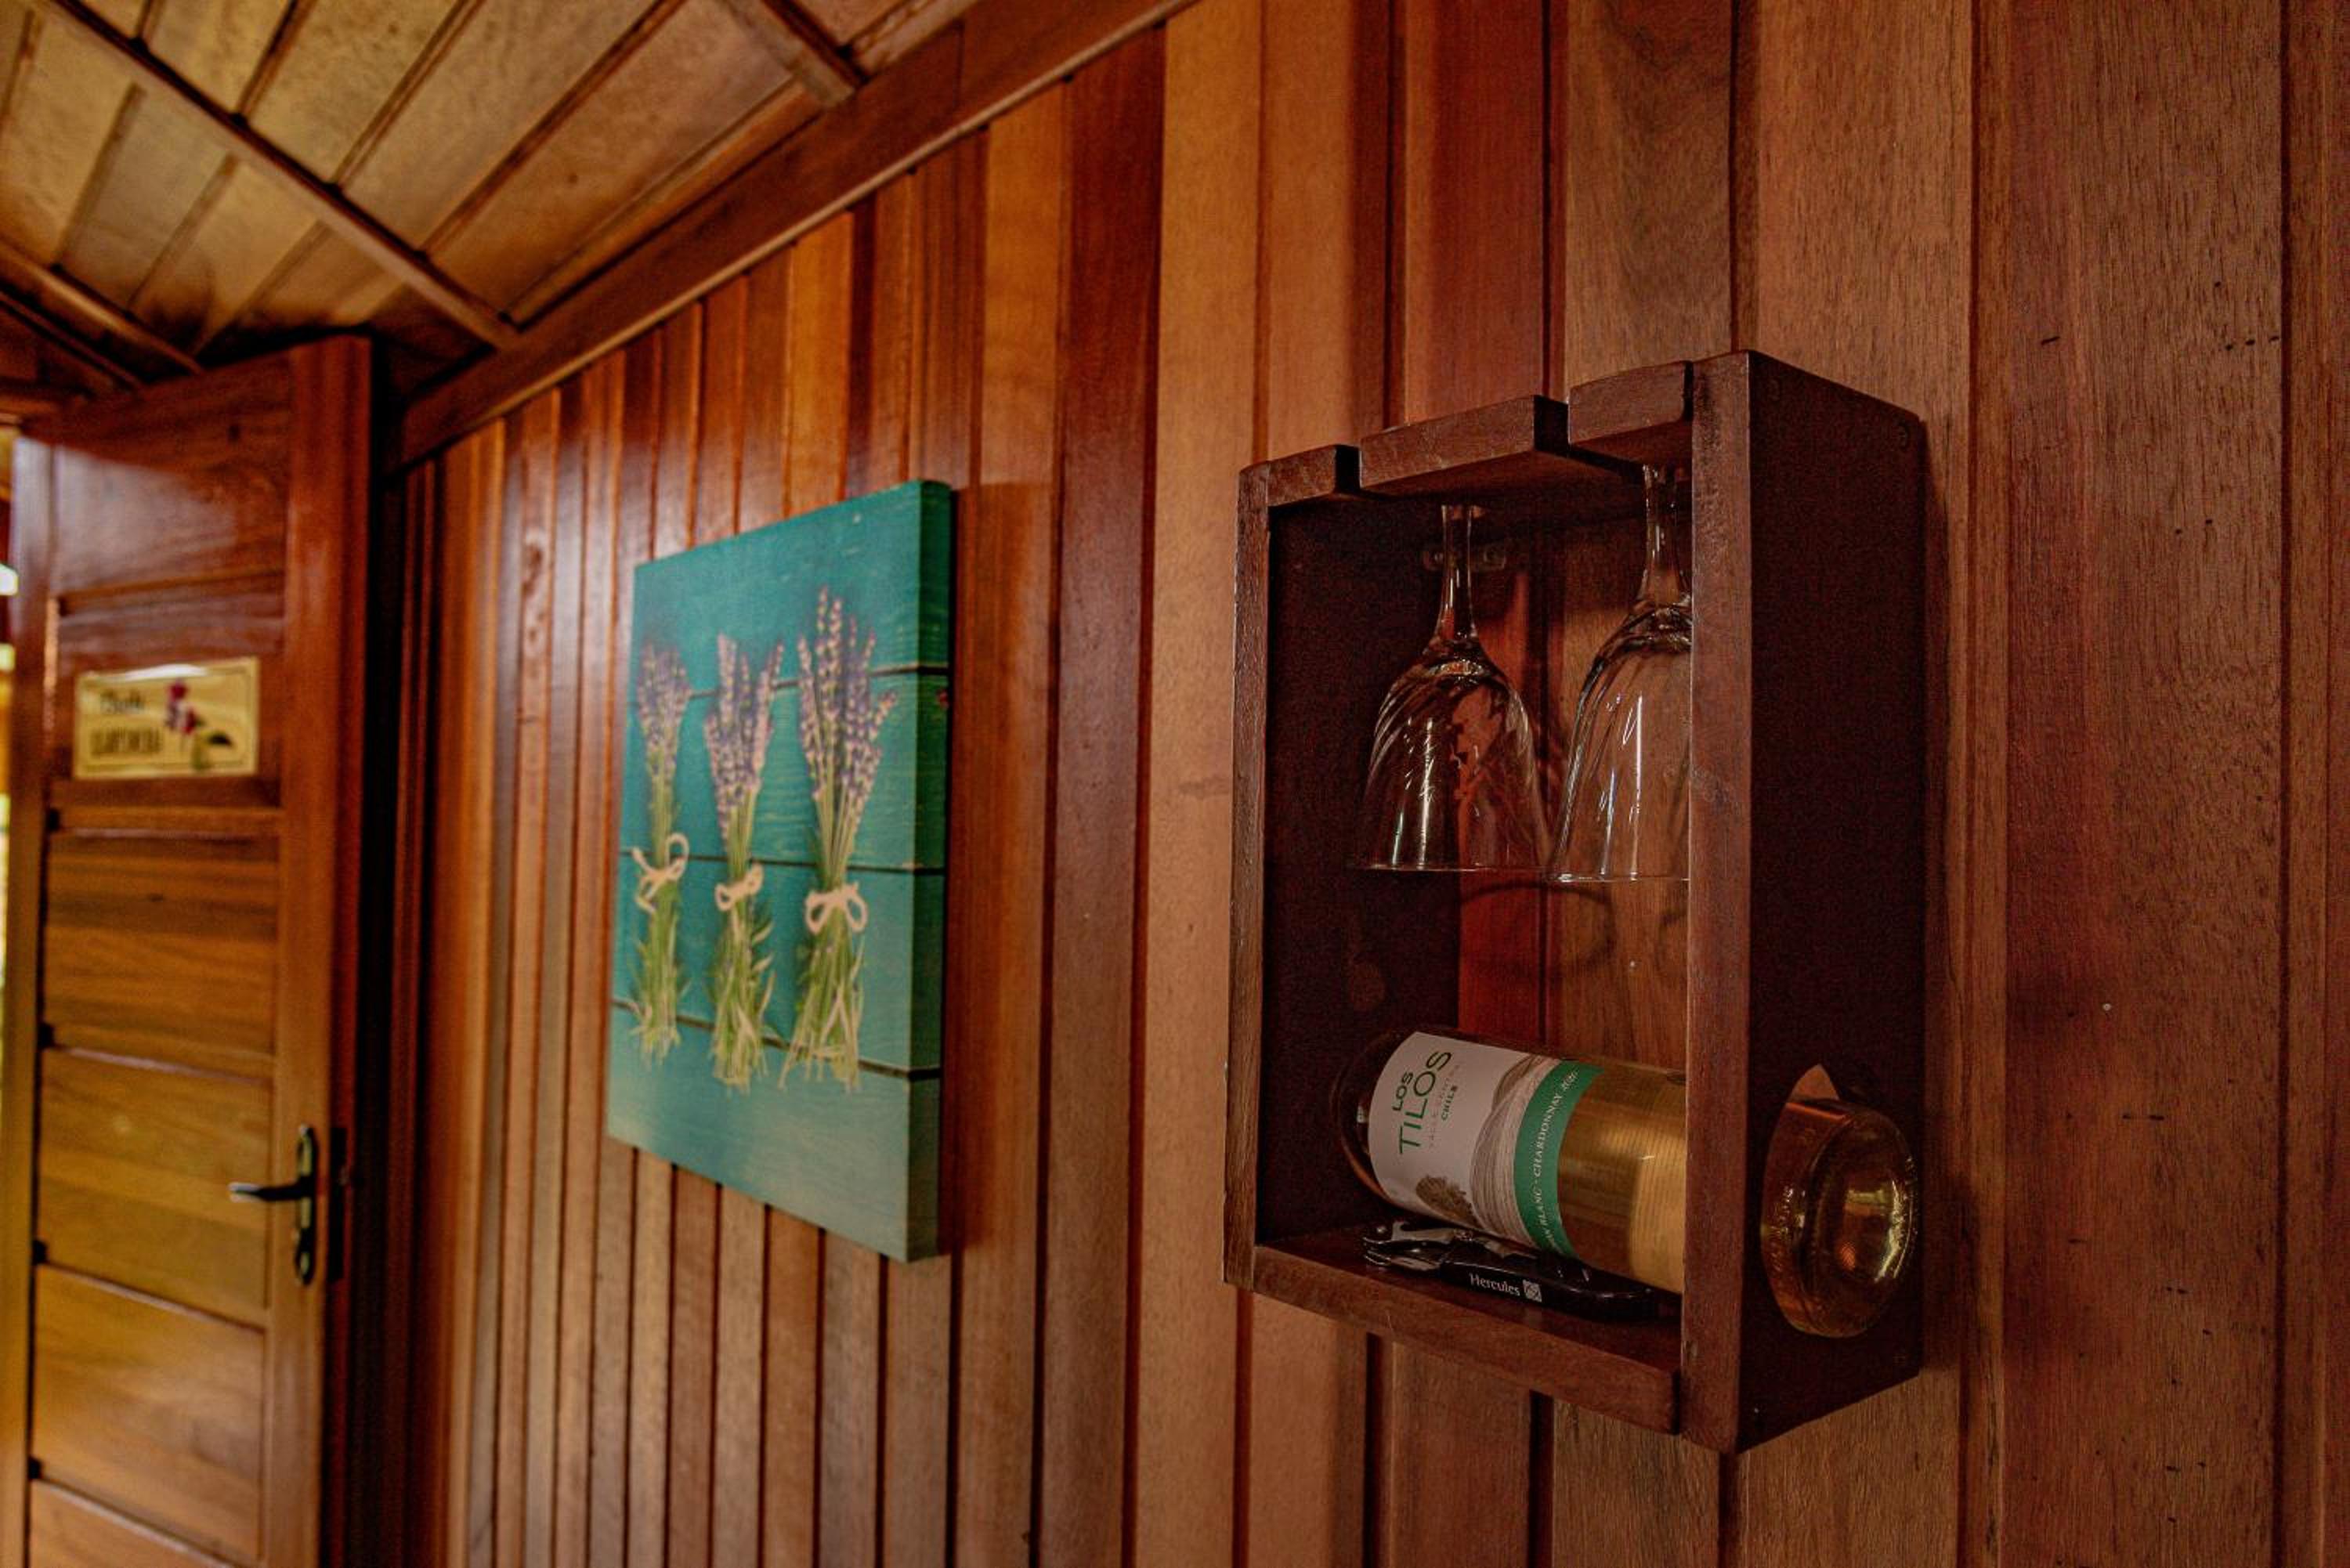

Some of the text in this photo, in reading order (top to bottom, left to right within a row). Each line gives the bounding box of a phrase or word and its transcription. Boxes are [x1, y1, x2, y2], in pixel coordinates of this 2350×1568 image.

[1391, 1071, 1414, 1112] LOS
[1398, 1050, 1453, 1154] TILOS
[1532, 1093, 1564, 1178] CHARDONNAY
[1469, 1272, 1521, 1298] Hercules
